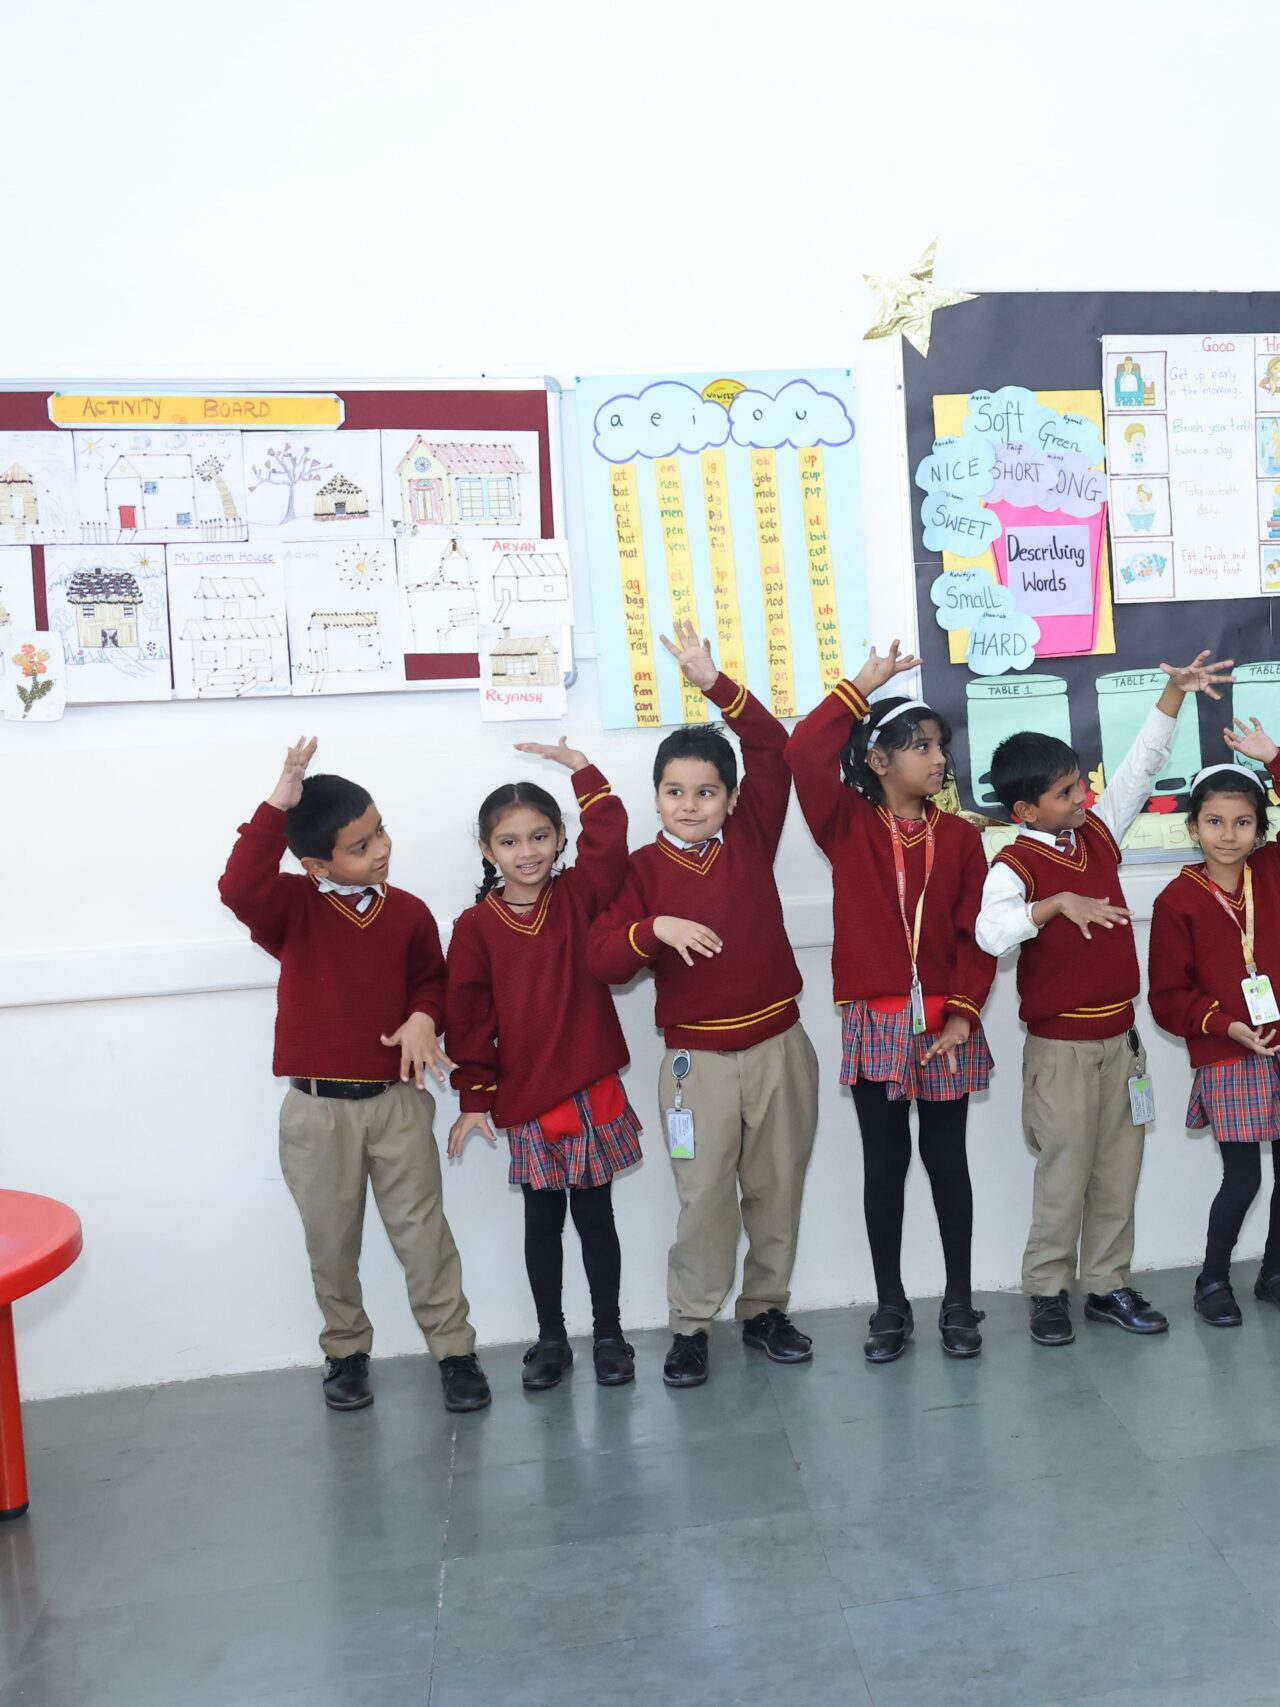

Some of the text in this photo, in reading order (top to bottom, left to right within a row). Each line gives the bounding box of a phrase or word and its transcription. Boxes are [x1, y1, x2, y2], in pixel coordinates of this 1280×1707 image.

[1202, 336, 1236, 352] GOOD
[1169, 366, 1237, 383] Get up early
[1183, 385, 1197, 396] the
[83, 397, 270, 420] ACTIVITY BOARD
[610, 408, 807, 427] a e i o u
[974, 400, 1024, 443] Soft
[1038, 420, 1083, 453] Green
[804, 455, 817, 468] up
[613, 469, 627, 482] at
[802, 470, 820, 482] cup
[930, 457, 980, 482] NICE
[988, 460, 1044, 483] SHORT
[754, 472, 772, 487] job
[1048, 469, 1103, 502] ONG
[612, 484, 629, 497] bat
[756, 488, 776, 499] mob
[805, 486, 822, 499] pup
[661, 494, 680, 504] ten
[614, 502, 630, 512] cat
[660, 508, 684, 518] men
[616, 514, 631, 528] fat
[759, 518, 777, 529] cob
[809, 515, 821, 526] ut
[931, 503, 992, 540] SWEET
[617, 530, 636, 543] hat
[666, 526, 684, 539] pen
[809, 530, 827, 542] but
[492, 541, 536, 553] ARYAN
[619, 547, 638, 558] mat
[809, 545, 827, 557] cut
[1006, 534, 1085, 568] Describing
[239, 551, 275, 562] House
[764, 562, 780, 575] od
[811, 561, 829, 572] hut
[812, 575, 830, 586] nut
[1021, 568, 1067, 592] Words
[626, 579, 640, 595] ag
[766, 580, 783, 595] god
[626, 594, 644, 609] bag
[766, 595, 783, 606] nod
[945, 585, 1002, 609] Small
[818, 604, 833, 616] ub
[718, 616, 732, 628] hip
[816, 619, 836, 631] cub
[628, 625, 643, 641] tag
[769, 639, 787, 651] box
[818, 635, 837, 646] rub
[971, 632, 1027, 657] HARD
[631, 641, 647, 655] rag
[768, 654, 786, 666] fox
[820, 650, 839, 661] tub
[635, 671, 652, 681] an
[826, 667, 840, 680] ug
[1112, 673, 1160, 688] TABLE 2
[634, 684, 653, 696] fan
[987, 685, 1033, 696] TABLE 1
[774, 705, 794, 717] hop
[637, 714, 659, 723] man
[1133, 823, 1186, 842] 4 5
